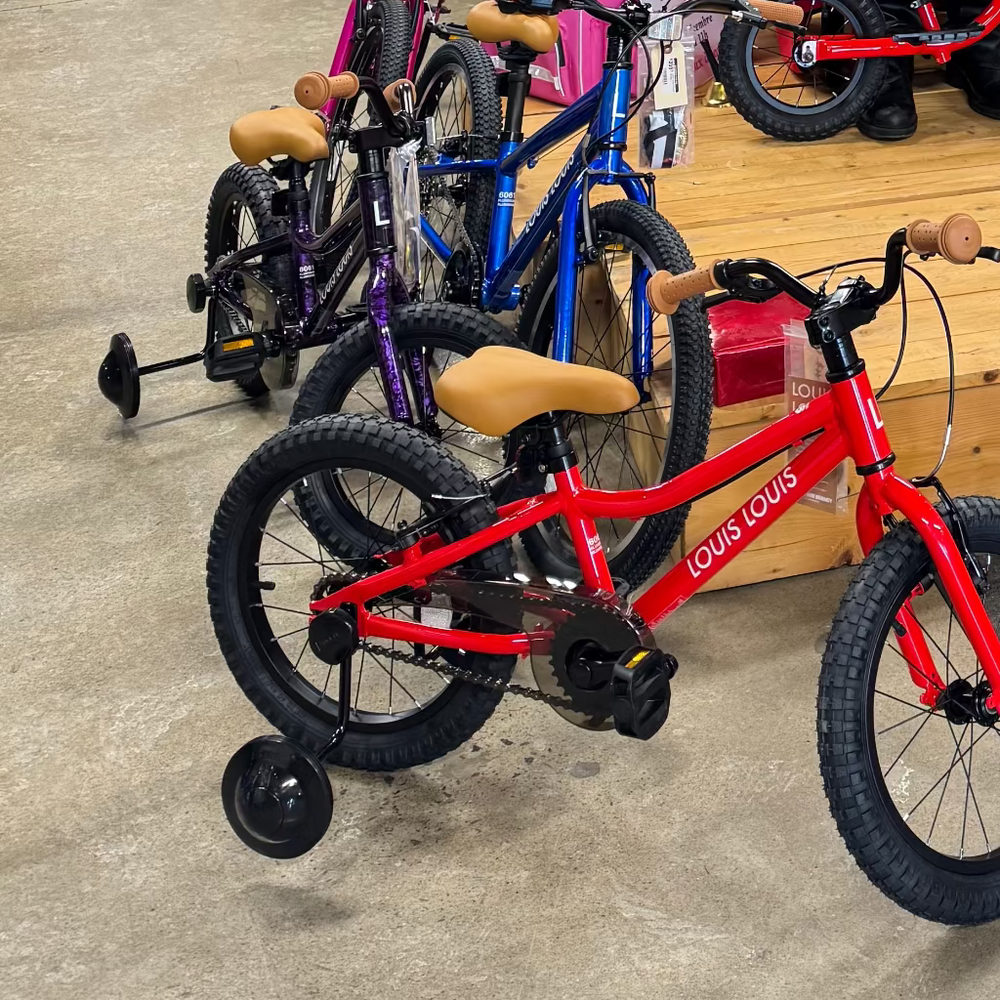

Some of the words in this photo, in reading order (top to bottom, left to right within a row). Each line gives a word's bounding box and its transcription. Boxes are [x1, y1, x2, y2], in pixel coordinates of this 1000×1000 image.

[373, 201, 390, 227] L
[867, 398, 884, 430] L
[687, 518, 741, 578] LOUIS
[741, 466, 797, 527] LOUIS
